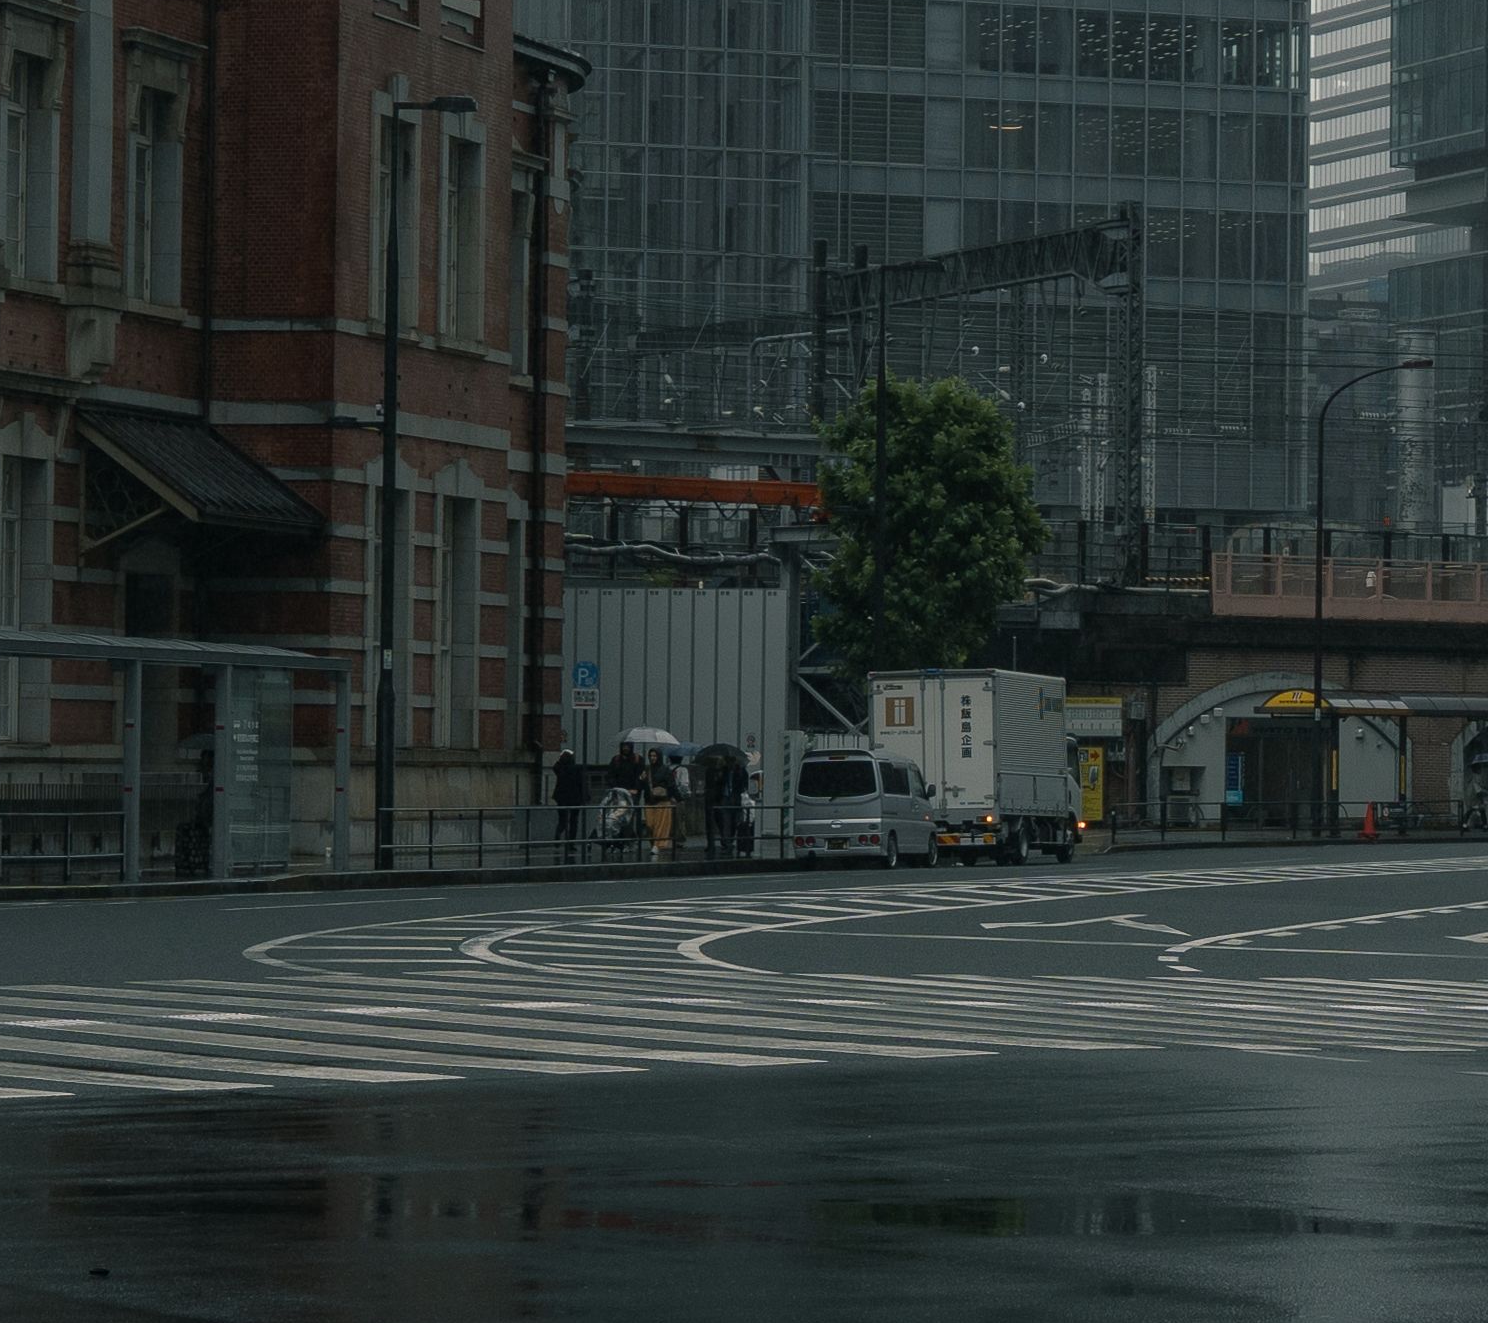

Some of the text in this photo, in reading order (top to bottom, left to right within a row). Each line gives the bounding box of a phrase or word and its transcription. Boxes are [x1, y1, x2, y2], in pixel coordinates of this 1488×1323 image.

[961, 695, 972, 758] 株飯島企画
